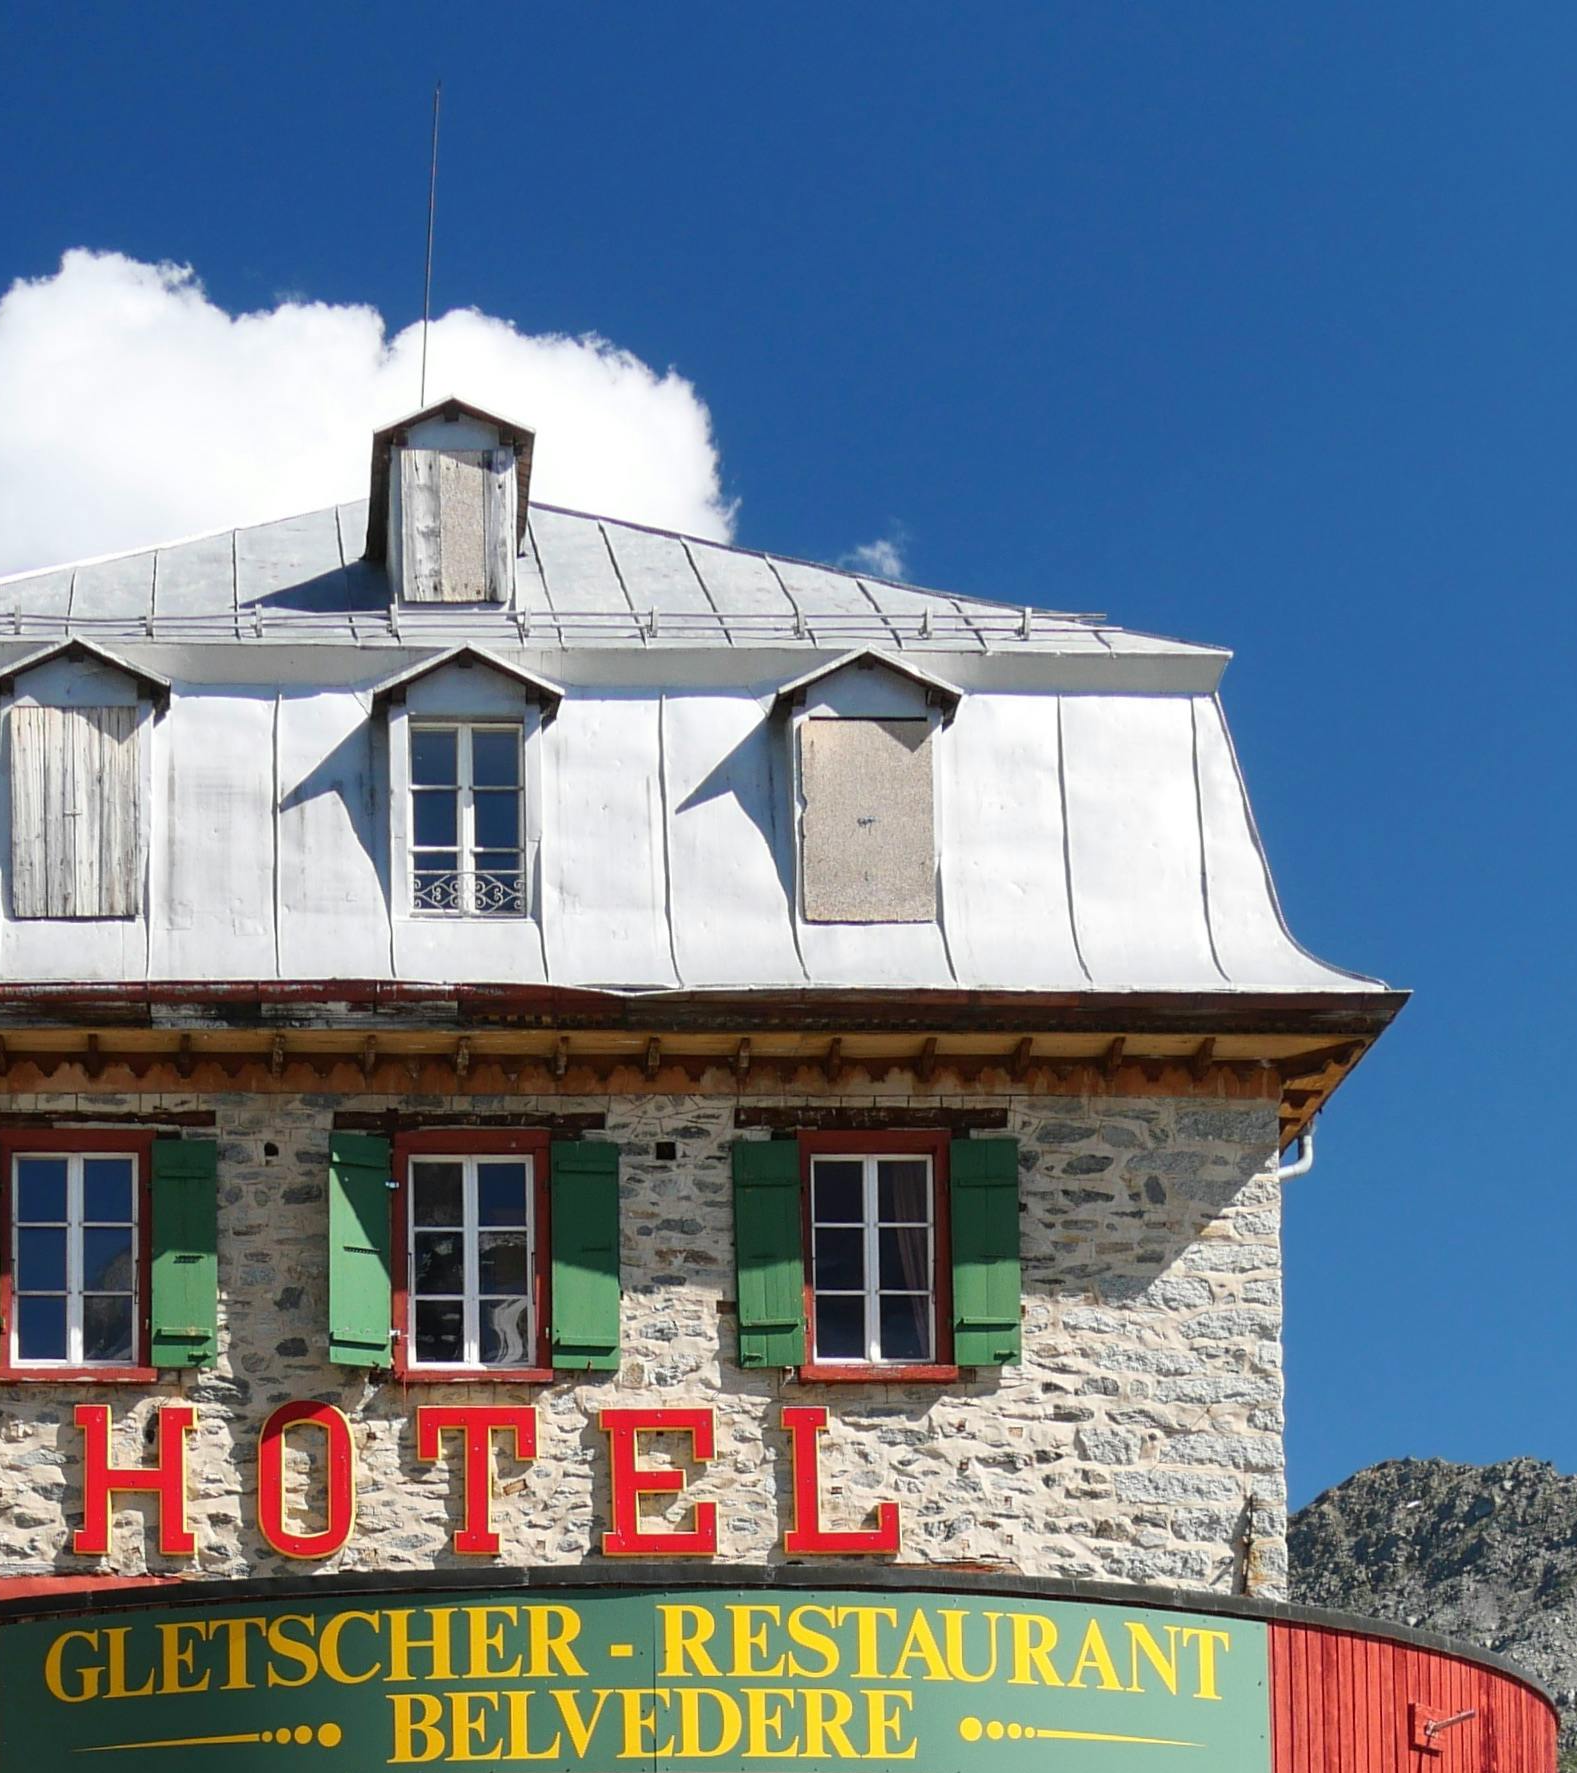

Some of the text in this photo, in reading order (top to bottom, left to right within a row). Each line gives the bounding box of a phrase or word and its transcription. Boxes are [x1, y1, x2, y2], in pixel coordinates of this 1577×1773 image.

[72, 1402, 901, 1558] HOTEL
[44, 1603, 588, 1703] GLETSCHER
[657, 1603, 1230, 1701] RESTAURANT
[386, 1686, 918, 1765] BELVEDERE
